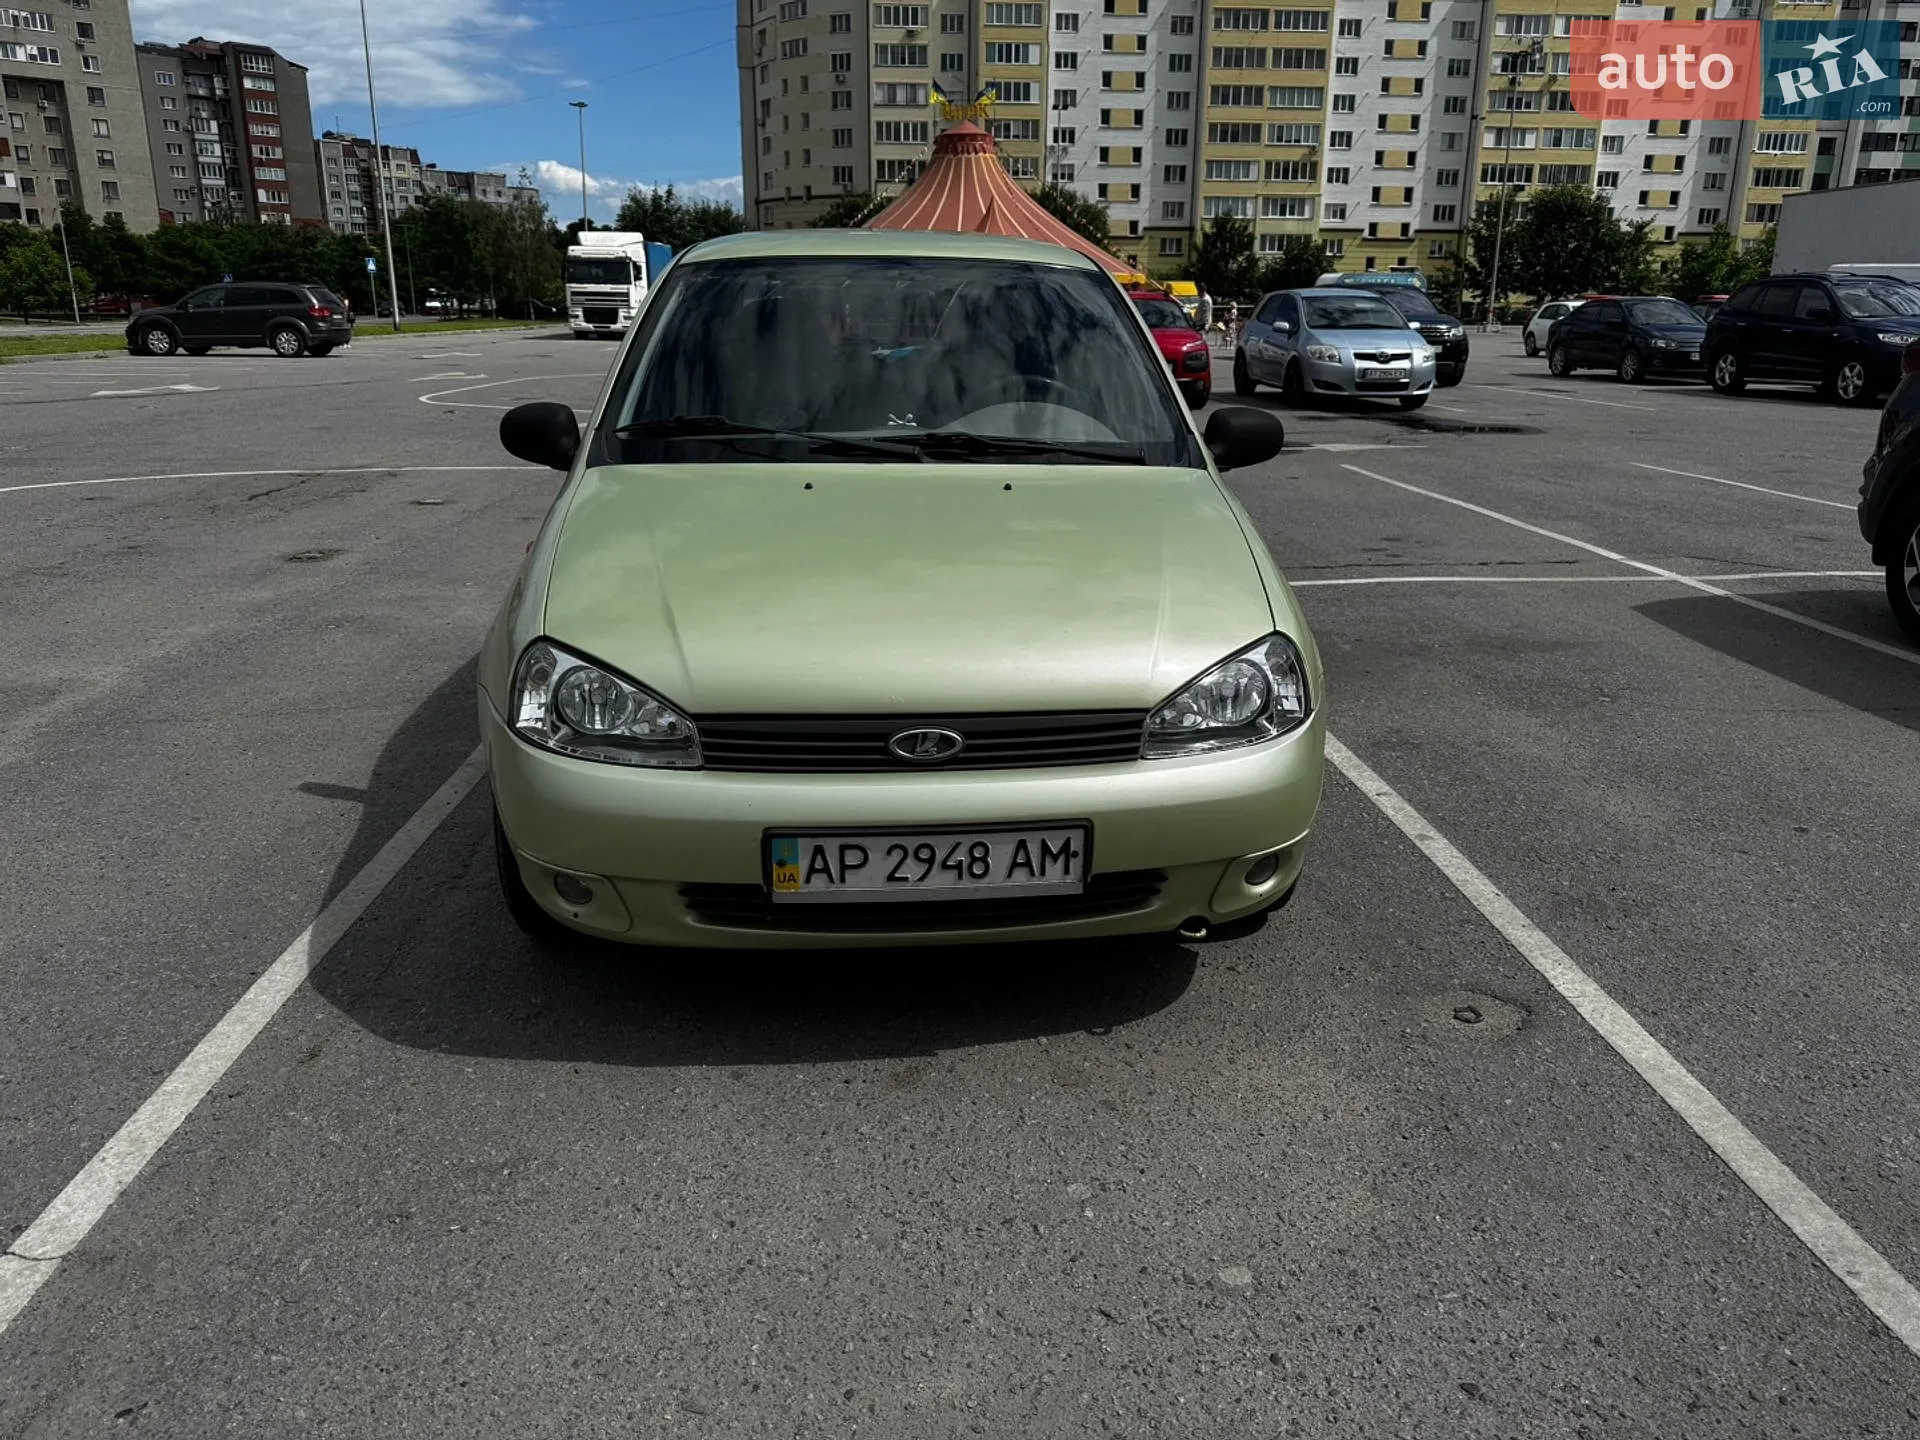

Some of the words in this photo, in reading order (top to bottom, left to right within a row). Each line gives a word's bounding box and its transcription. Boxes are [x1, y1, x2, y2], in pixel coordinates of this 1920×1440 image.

[804, 843, 870, 884] AP
[885, 841, 992, 882] 2948
[1007, 836, 1072, 879] AM
[776, 873, 797, 884] UA
